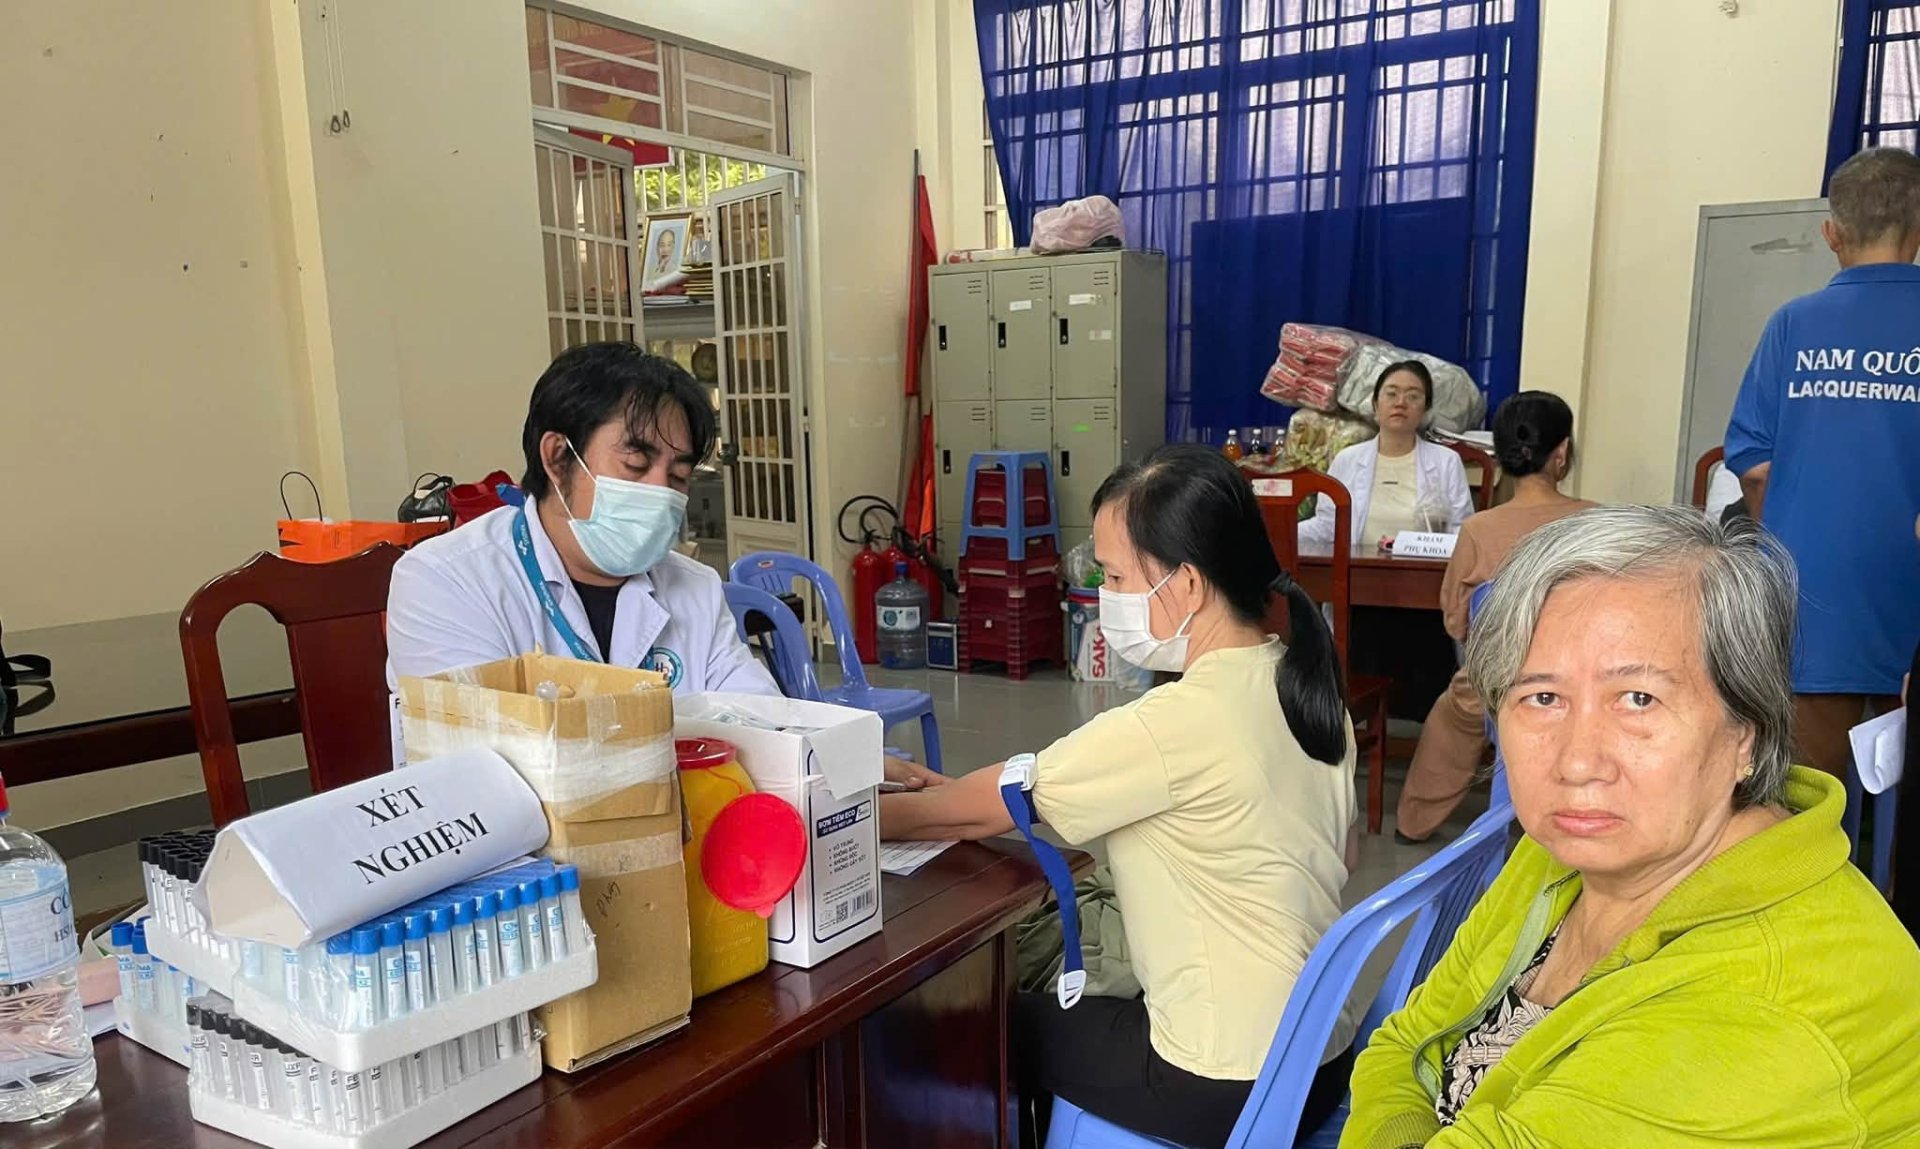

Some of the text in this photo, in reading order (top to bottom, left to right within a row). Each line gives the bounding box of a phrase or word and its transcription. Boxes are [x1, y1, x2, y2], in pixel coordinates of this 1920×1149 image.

[1795, 348, 1856, 372] NAM
[355, 785, 426, 827] XÉT
[351, 812, 490, 885] NGHIỆM
